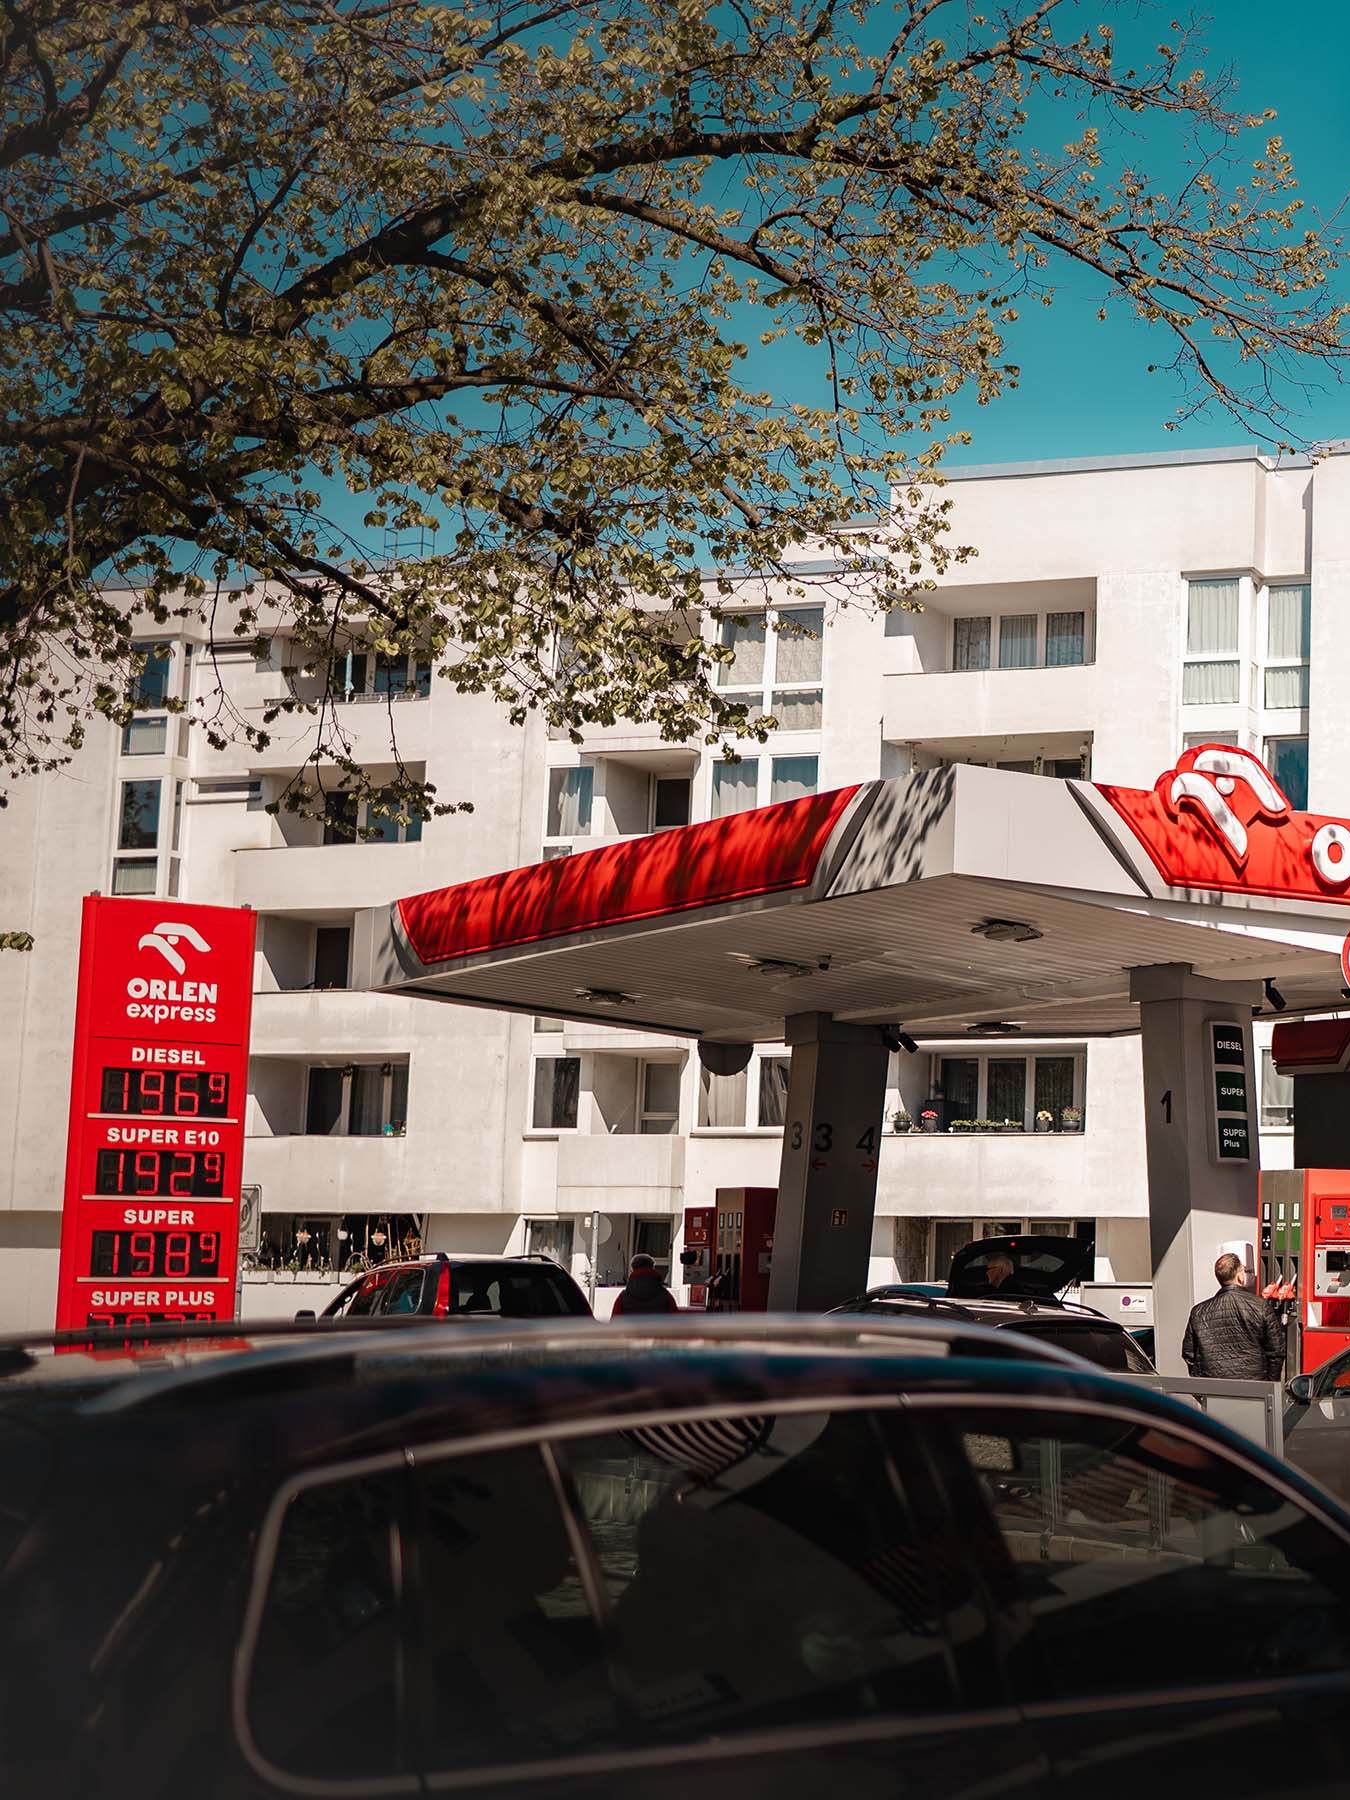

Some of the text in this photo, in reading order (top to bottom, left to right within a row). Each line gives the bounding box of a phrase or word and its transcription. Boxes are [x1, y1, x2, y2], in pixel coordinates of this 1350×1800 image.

[127, 977, 218, 1004] ORLEN
[126, 1003, 216, 1024] express
[1216, 1041, 1242, 1051] DIESEL
[131, 1047, 206, 1065] DIESEL
[1221, 1087, 1245, 1097] SUPER
[1160, 1090, 1172, 1124] 1
[106, 1127, 220, 1145] SUPER E10
[791, 1121, 803, 1150] 3
[814, 1123, 832, 1152] 3
[855, 1126, 875, 1155] 4
[1223, 1128, 1247, 1137] SUPER
[1223, 1139, 1241, 1148] Plus
[123, 1209, 195, 1225] SUPER
[90, 1291, 215, 1306] SUPER PLUS
